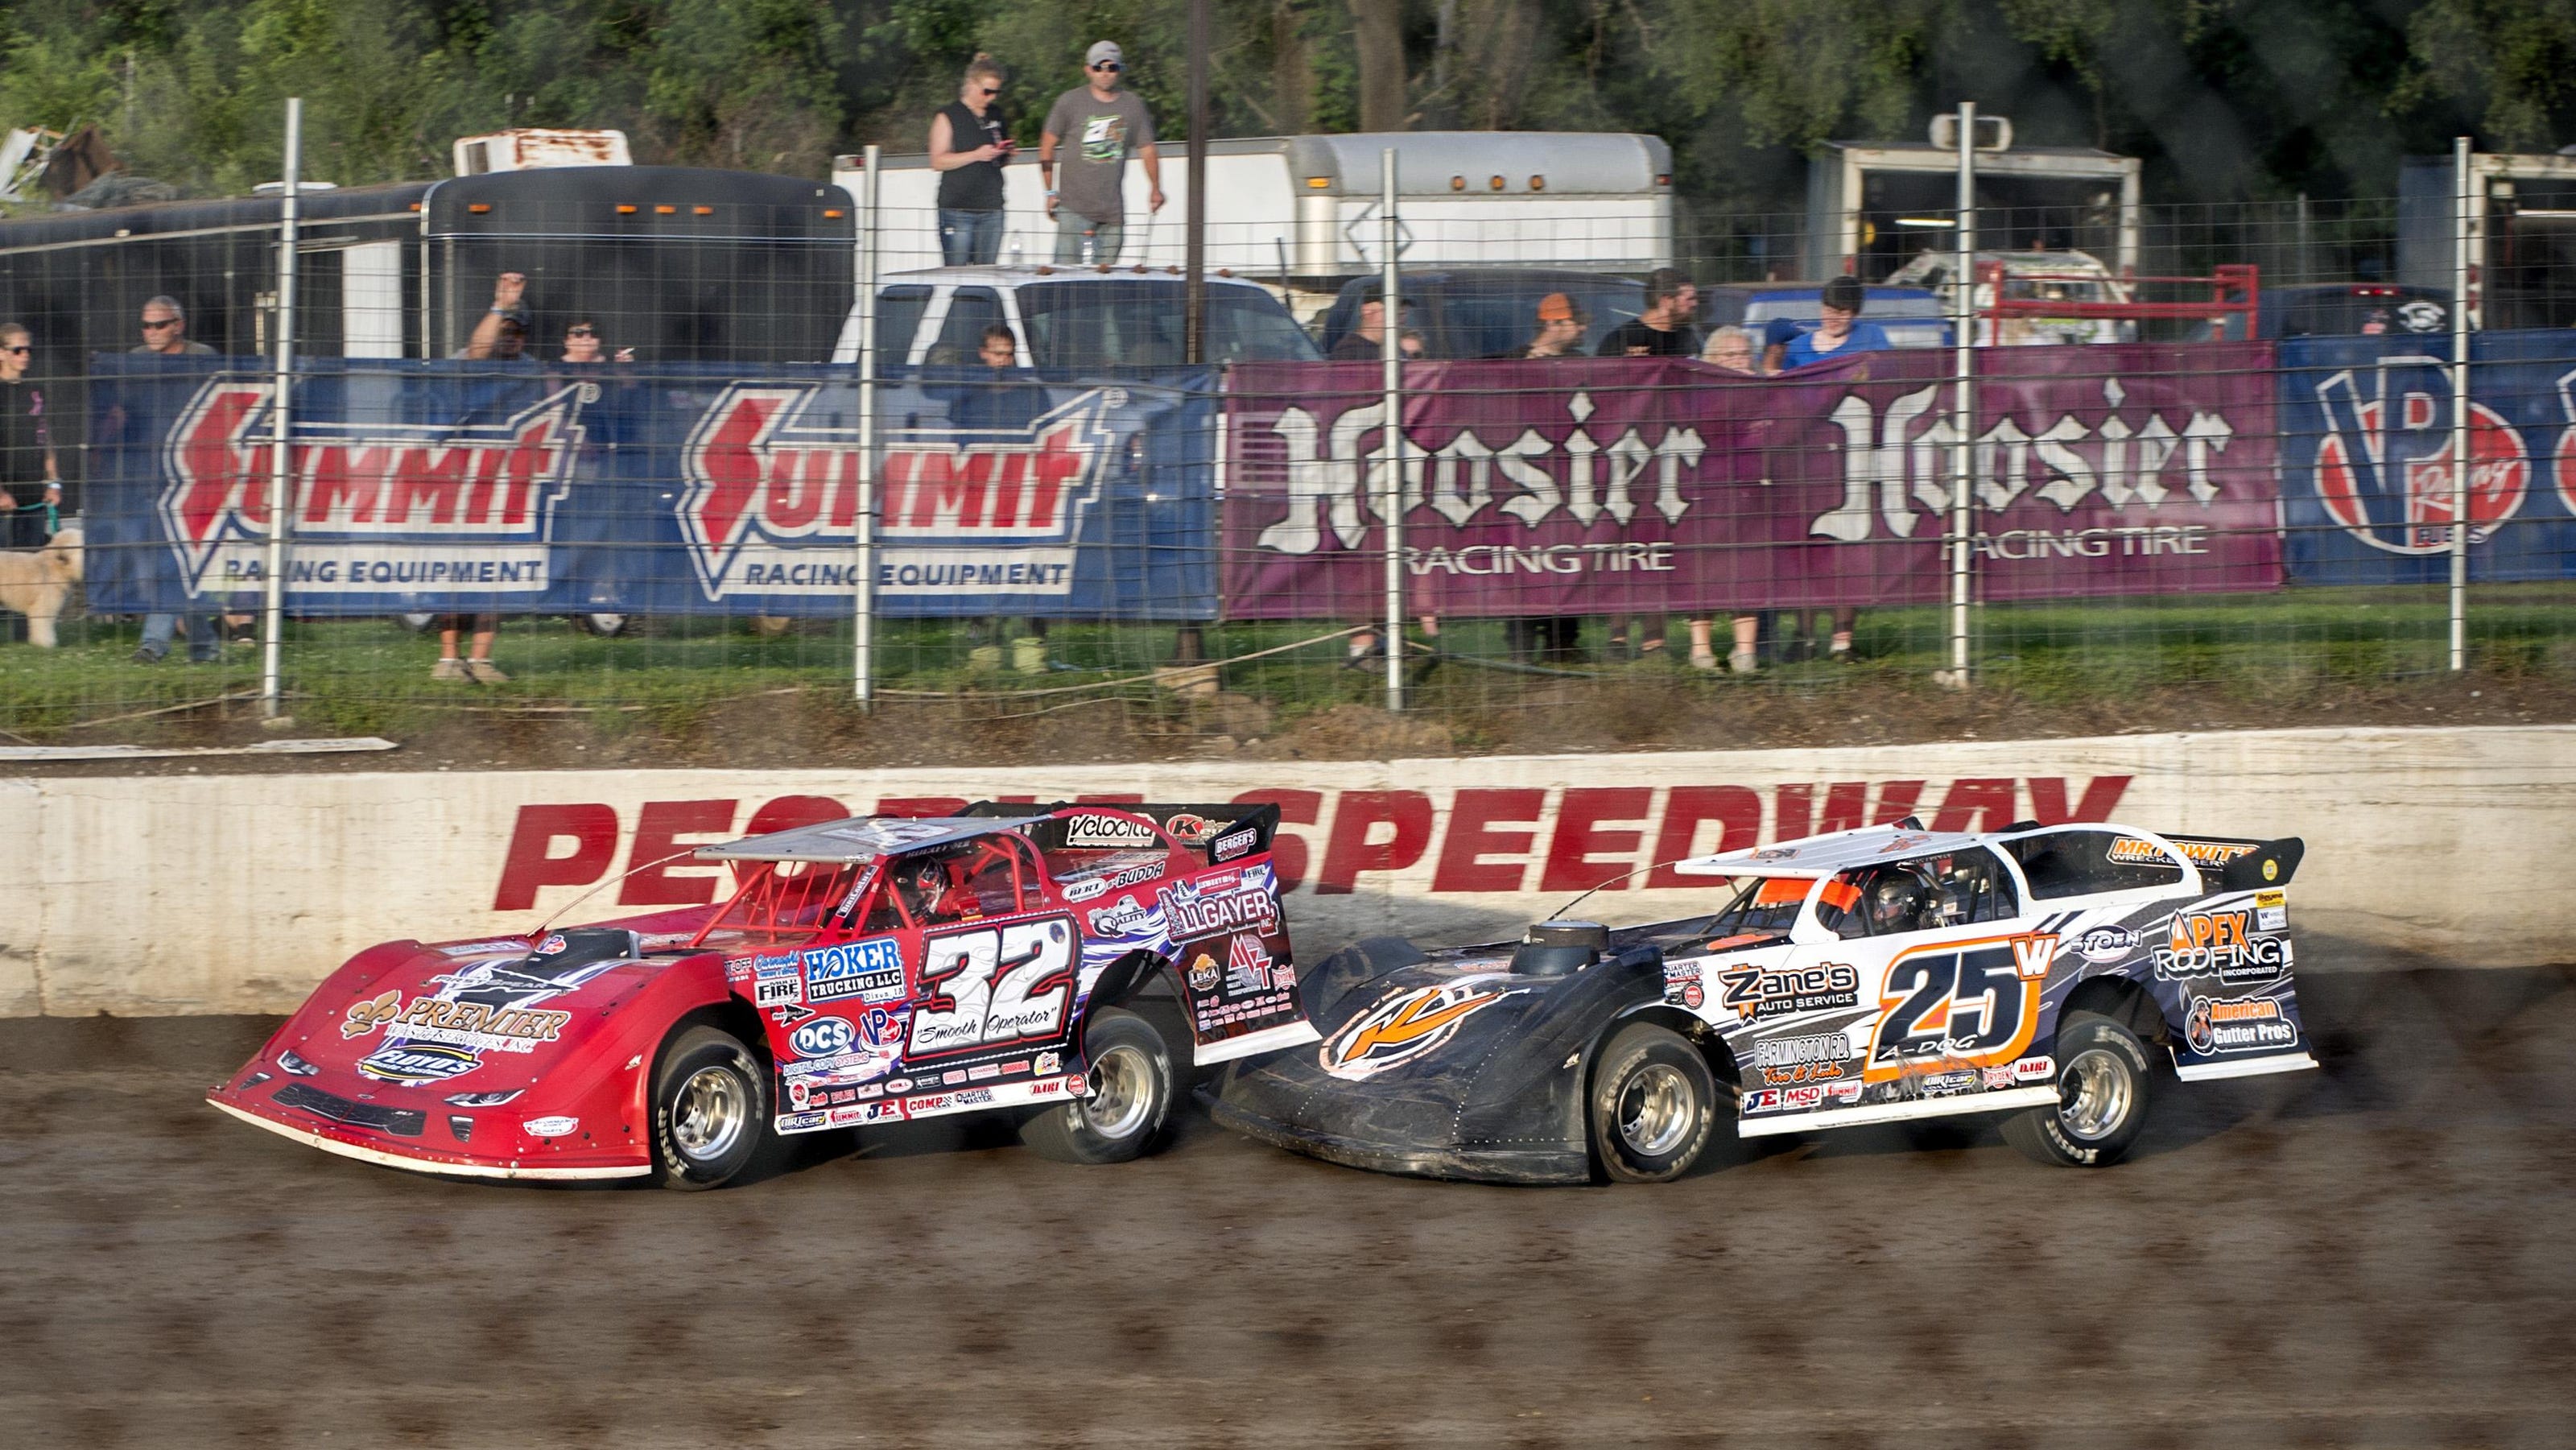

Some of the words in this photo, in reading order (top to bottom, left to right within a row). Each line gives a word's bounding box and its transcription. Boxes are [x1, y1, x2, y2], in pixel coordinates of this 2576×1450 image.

[1810, 377, 2233, 541] Hoosier
[2315, 356, 2462, 551] VP
[1257, 391, 1707, 555] Hoosier
[2121, 524, 2209, 556] TIRE
[2418, 526, 2490, 544] FUES
[1400, 543, 1583, 576] RACING
[1592, 541, 1676, 572] TIRE
[226, 560, 338, 583] RANG
[350, 560, 543, 584] EQUIPMENT
[881, 564, 1068, 586] EQUIPMENT
[1216, 830, 1255, 852] BERGER'S
[2113, 839, 2152, 856] MR
[2112, 853, 2178, 864] WRECKE
[1117, 862, 1164, 886] BUDDA
[1247, 867, 1265, 878] FIRE
[1069, 883, 1100, 896] BERT
[1095, 911, 1146, 936] QUALITY
[2070, 929, 2141, 952] STOEN
[806, 939, 899, 981] HOKER
[2155, 940, 2281, 973] ROOFING
[1190, 969, 1218, 982] LEKA
[2223, 966, 2277, 977] INCORPORATED
[758, 983, 799, 1001] FIRE
[811, 977, 873, 998] TRUCKING
[876, 973, 902, 985] LLC
[910, 919, 1070, 1055] 32
[1722, 965, 1853, 1005] Zane's
[1757, 1000, 1792, 1012] AUTO
[1797, 994, 1853, 1007] SERVICE
[1874, 945, 2023, 1064] 25
[2013, 936, 2058, 980] W
[2211, 1001, 2278, 1021] American
[395, 998, 569, 1039] PREMIER
[861, 1009, 888, 1046] VP
[799, 1023, 847, 1050] DCS
[2214, 1026, 2256, 1044] Gutter
[2256, 1023, 2292, 1041] Pros
[1757, 1035, 1829, 1068] FARMINGTON
[1878, 1034, 1978, 1060] A-DOG
[373, 1049, 481, 1073] FLOYD'S
[784, 1061, 813, 1076] DIGITAL
[813, 1059, 836, 1071] COPY
[836, 1053, 869, 1068] SYSTEMS
[1984, 1067, 2014, 1085] DRYDENE
[909, 1097, 943, 1111] COMP
[1745, 1089, 1777, 1111] JE
[1785, 1088, 1820, 1103] MSD
[867, 1101, 895, 1120] JE
